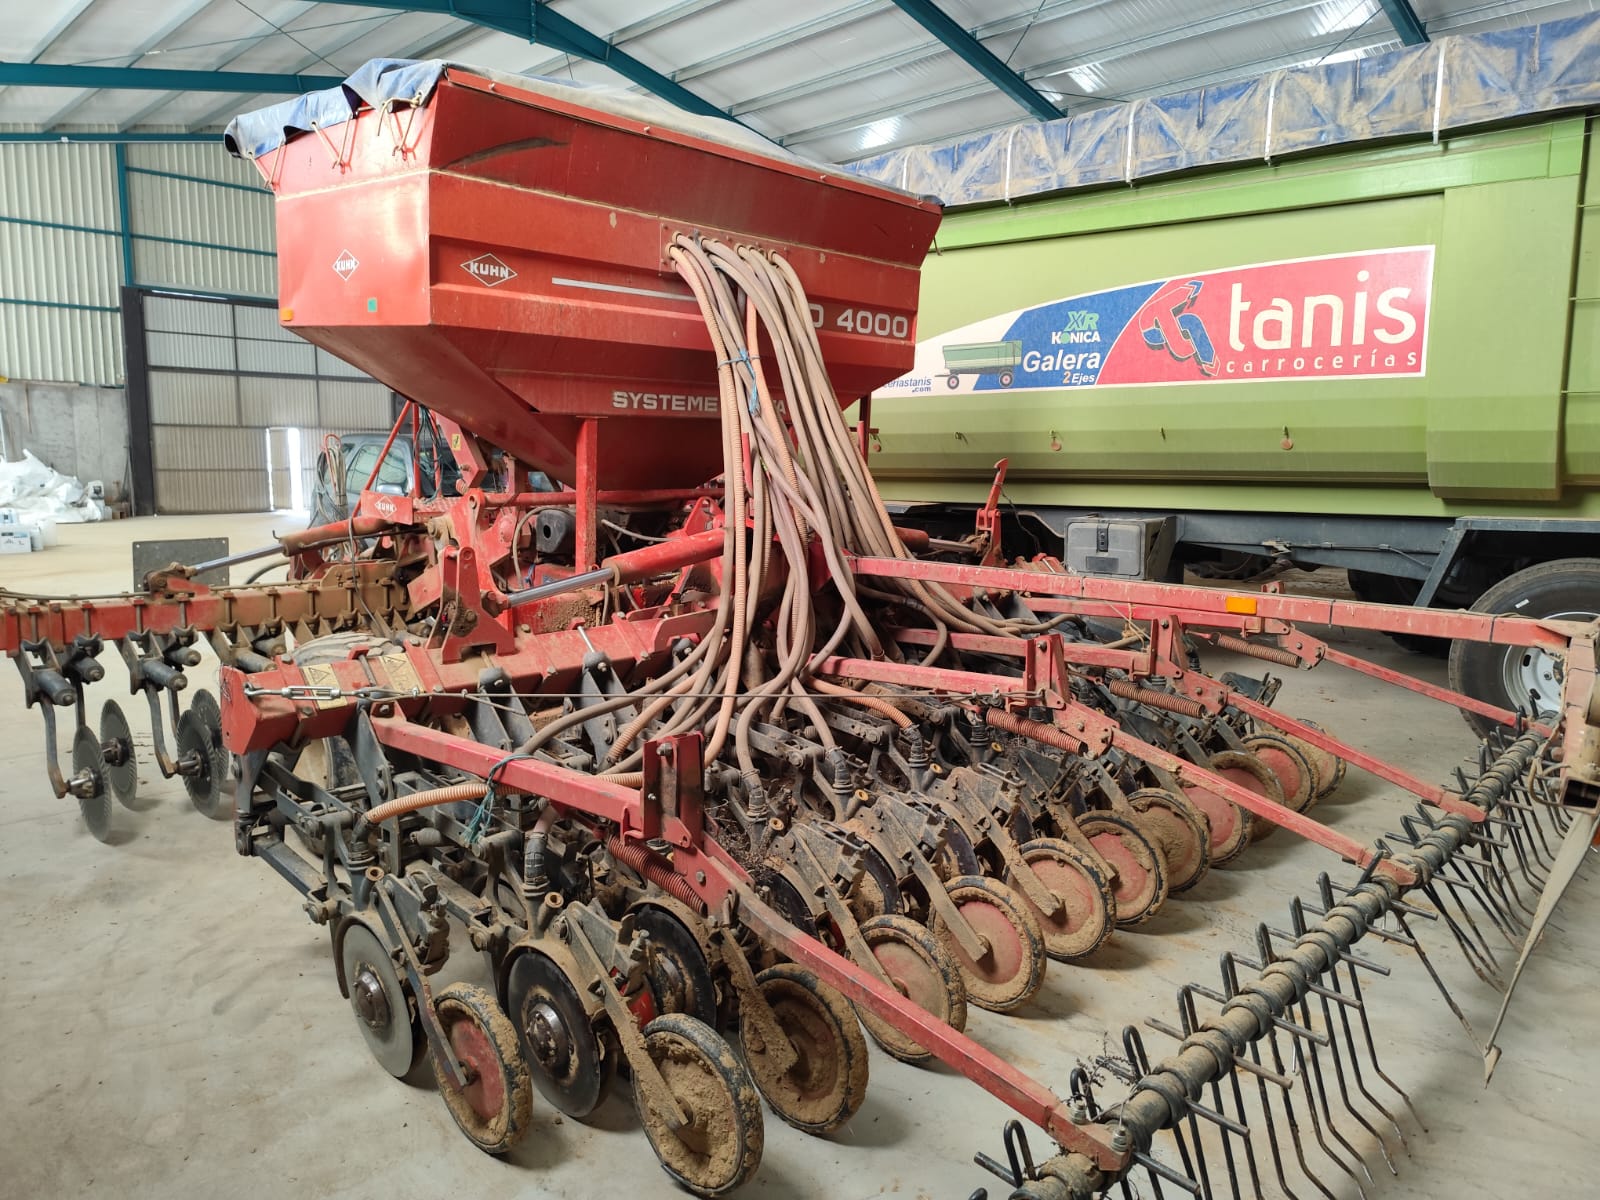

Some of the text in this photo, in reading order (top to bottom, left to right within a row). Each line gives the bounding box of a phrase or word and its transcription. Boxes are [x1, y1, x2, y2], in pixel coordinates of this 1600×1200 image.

[336, 258, 357, 272] KUHN
[469, 261, 510, 278] KUHN
[1063, 310, 1100, 331] XR
[1229, 270, 1417, 352] tanis
[836, 308, 908, 338] 4000
[1022, 349, 1101, 373] Galera
[1226, 348, 1417, 373] carrocerías
[1062, 371, 1096, 385] 2 Ejes
[612, 391, 718, 412] SYSTEME
